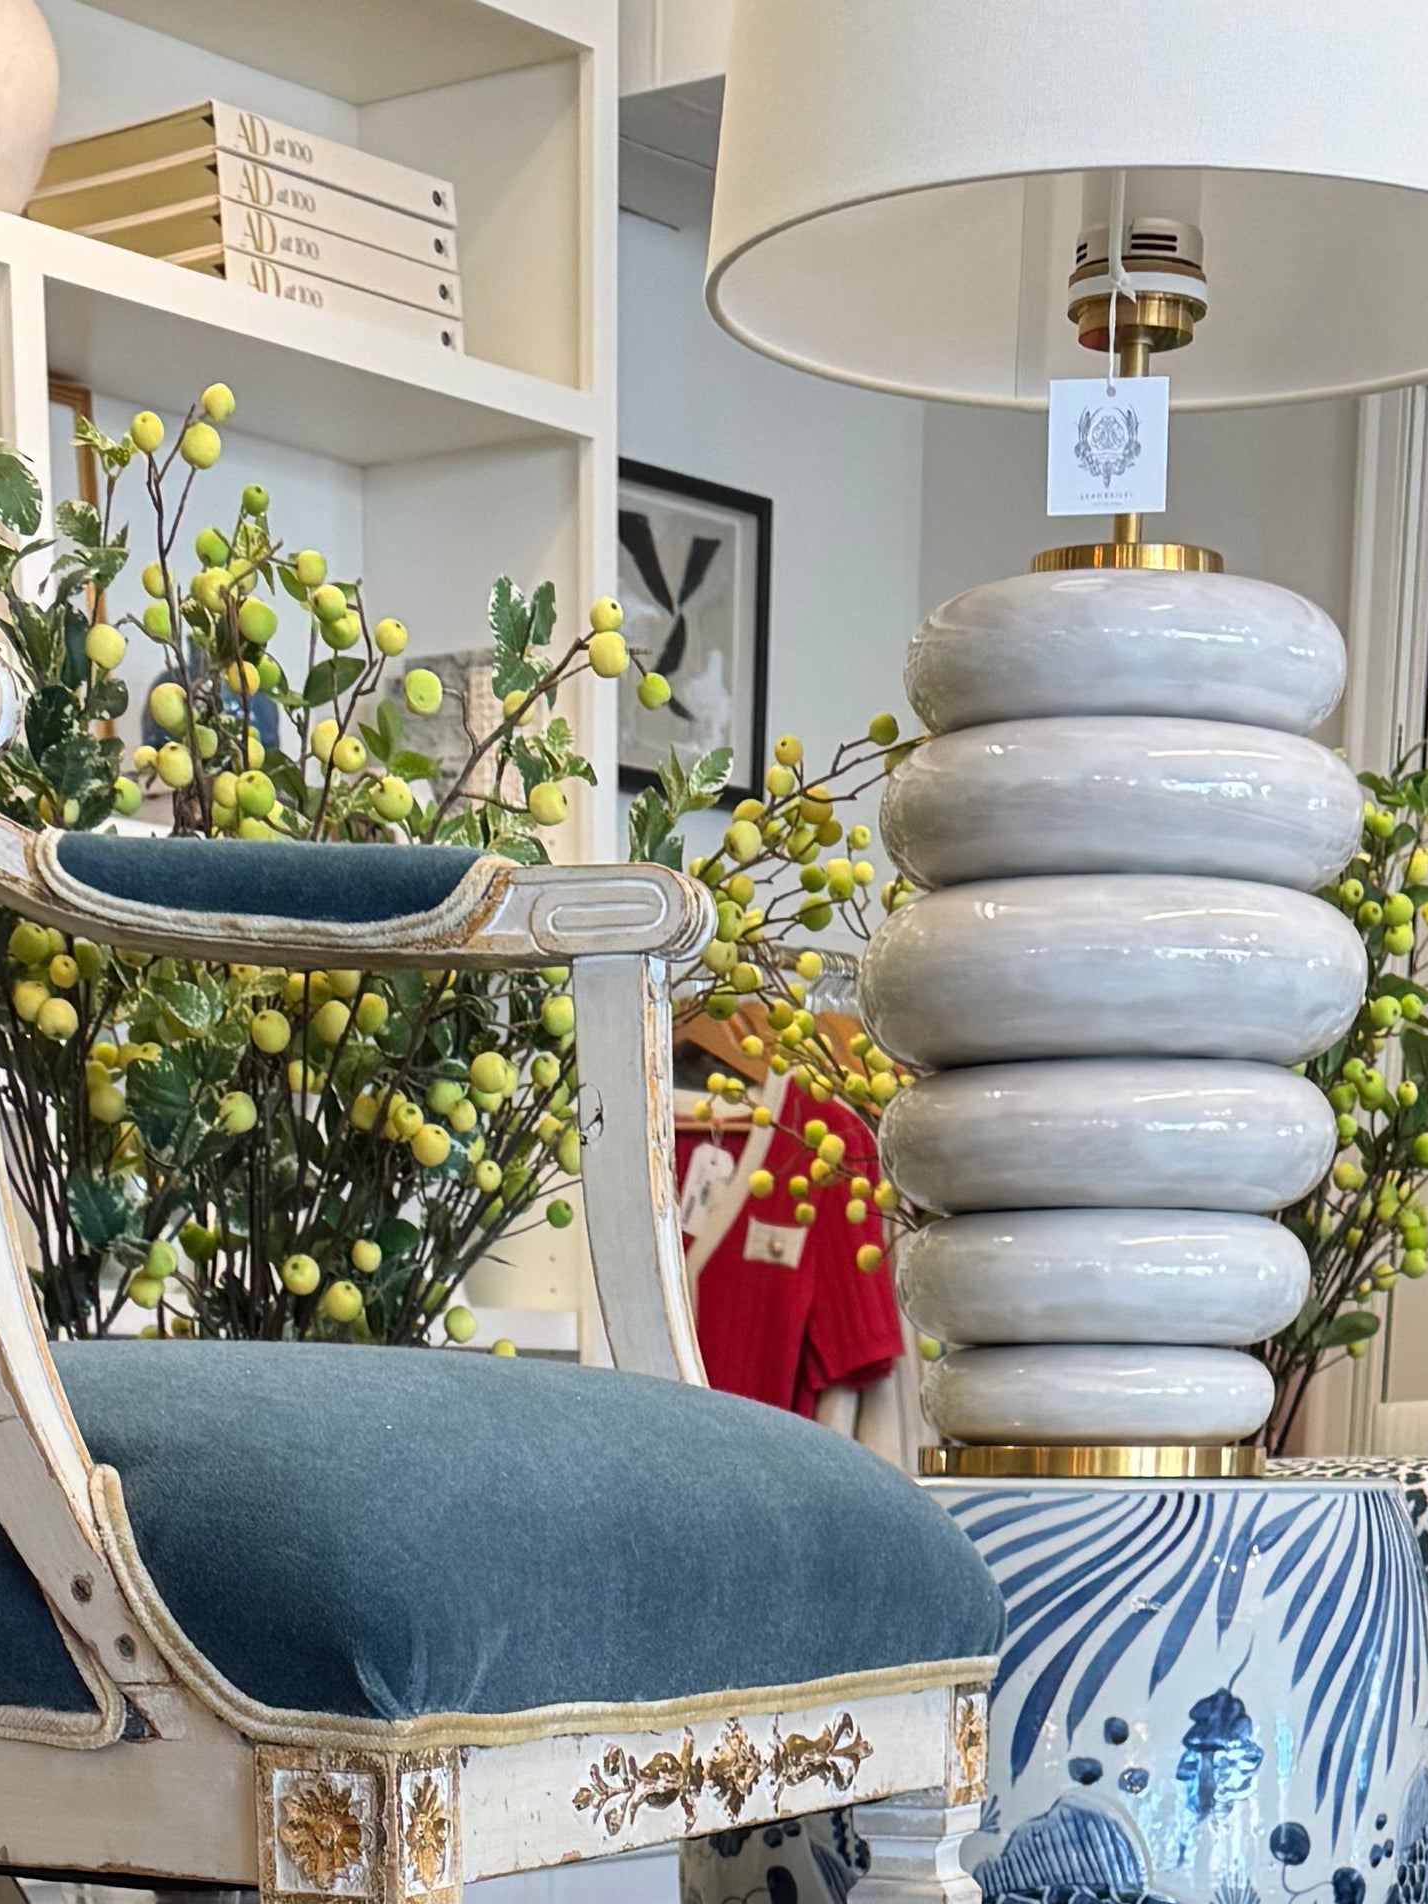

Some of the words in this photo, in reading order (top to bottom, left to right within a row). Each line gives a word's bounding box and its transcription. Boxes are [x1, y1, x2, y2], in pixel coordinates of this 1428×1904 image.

[236, 113, 270, 157] AD
[289, 140, 314, 163] 100
[239, 163, 274, 207] AD
[292, 190, 317, 213] 100
[242, 211, 277, 255] AD
[295, 237, 320, 261] 100
